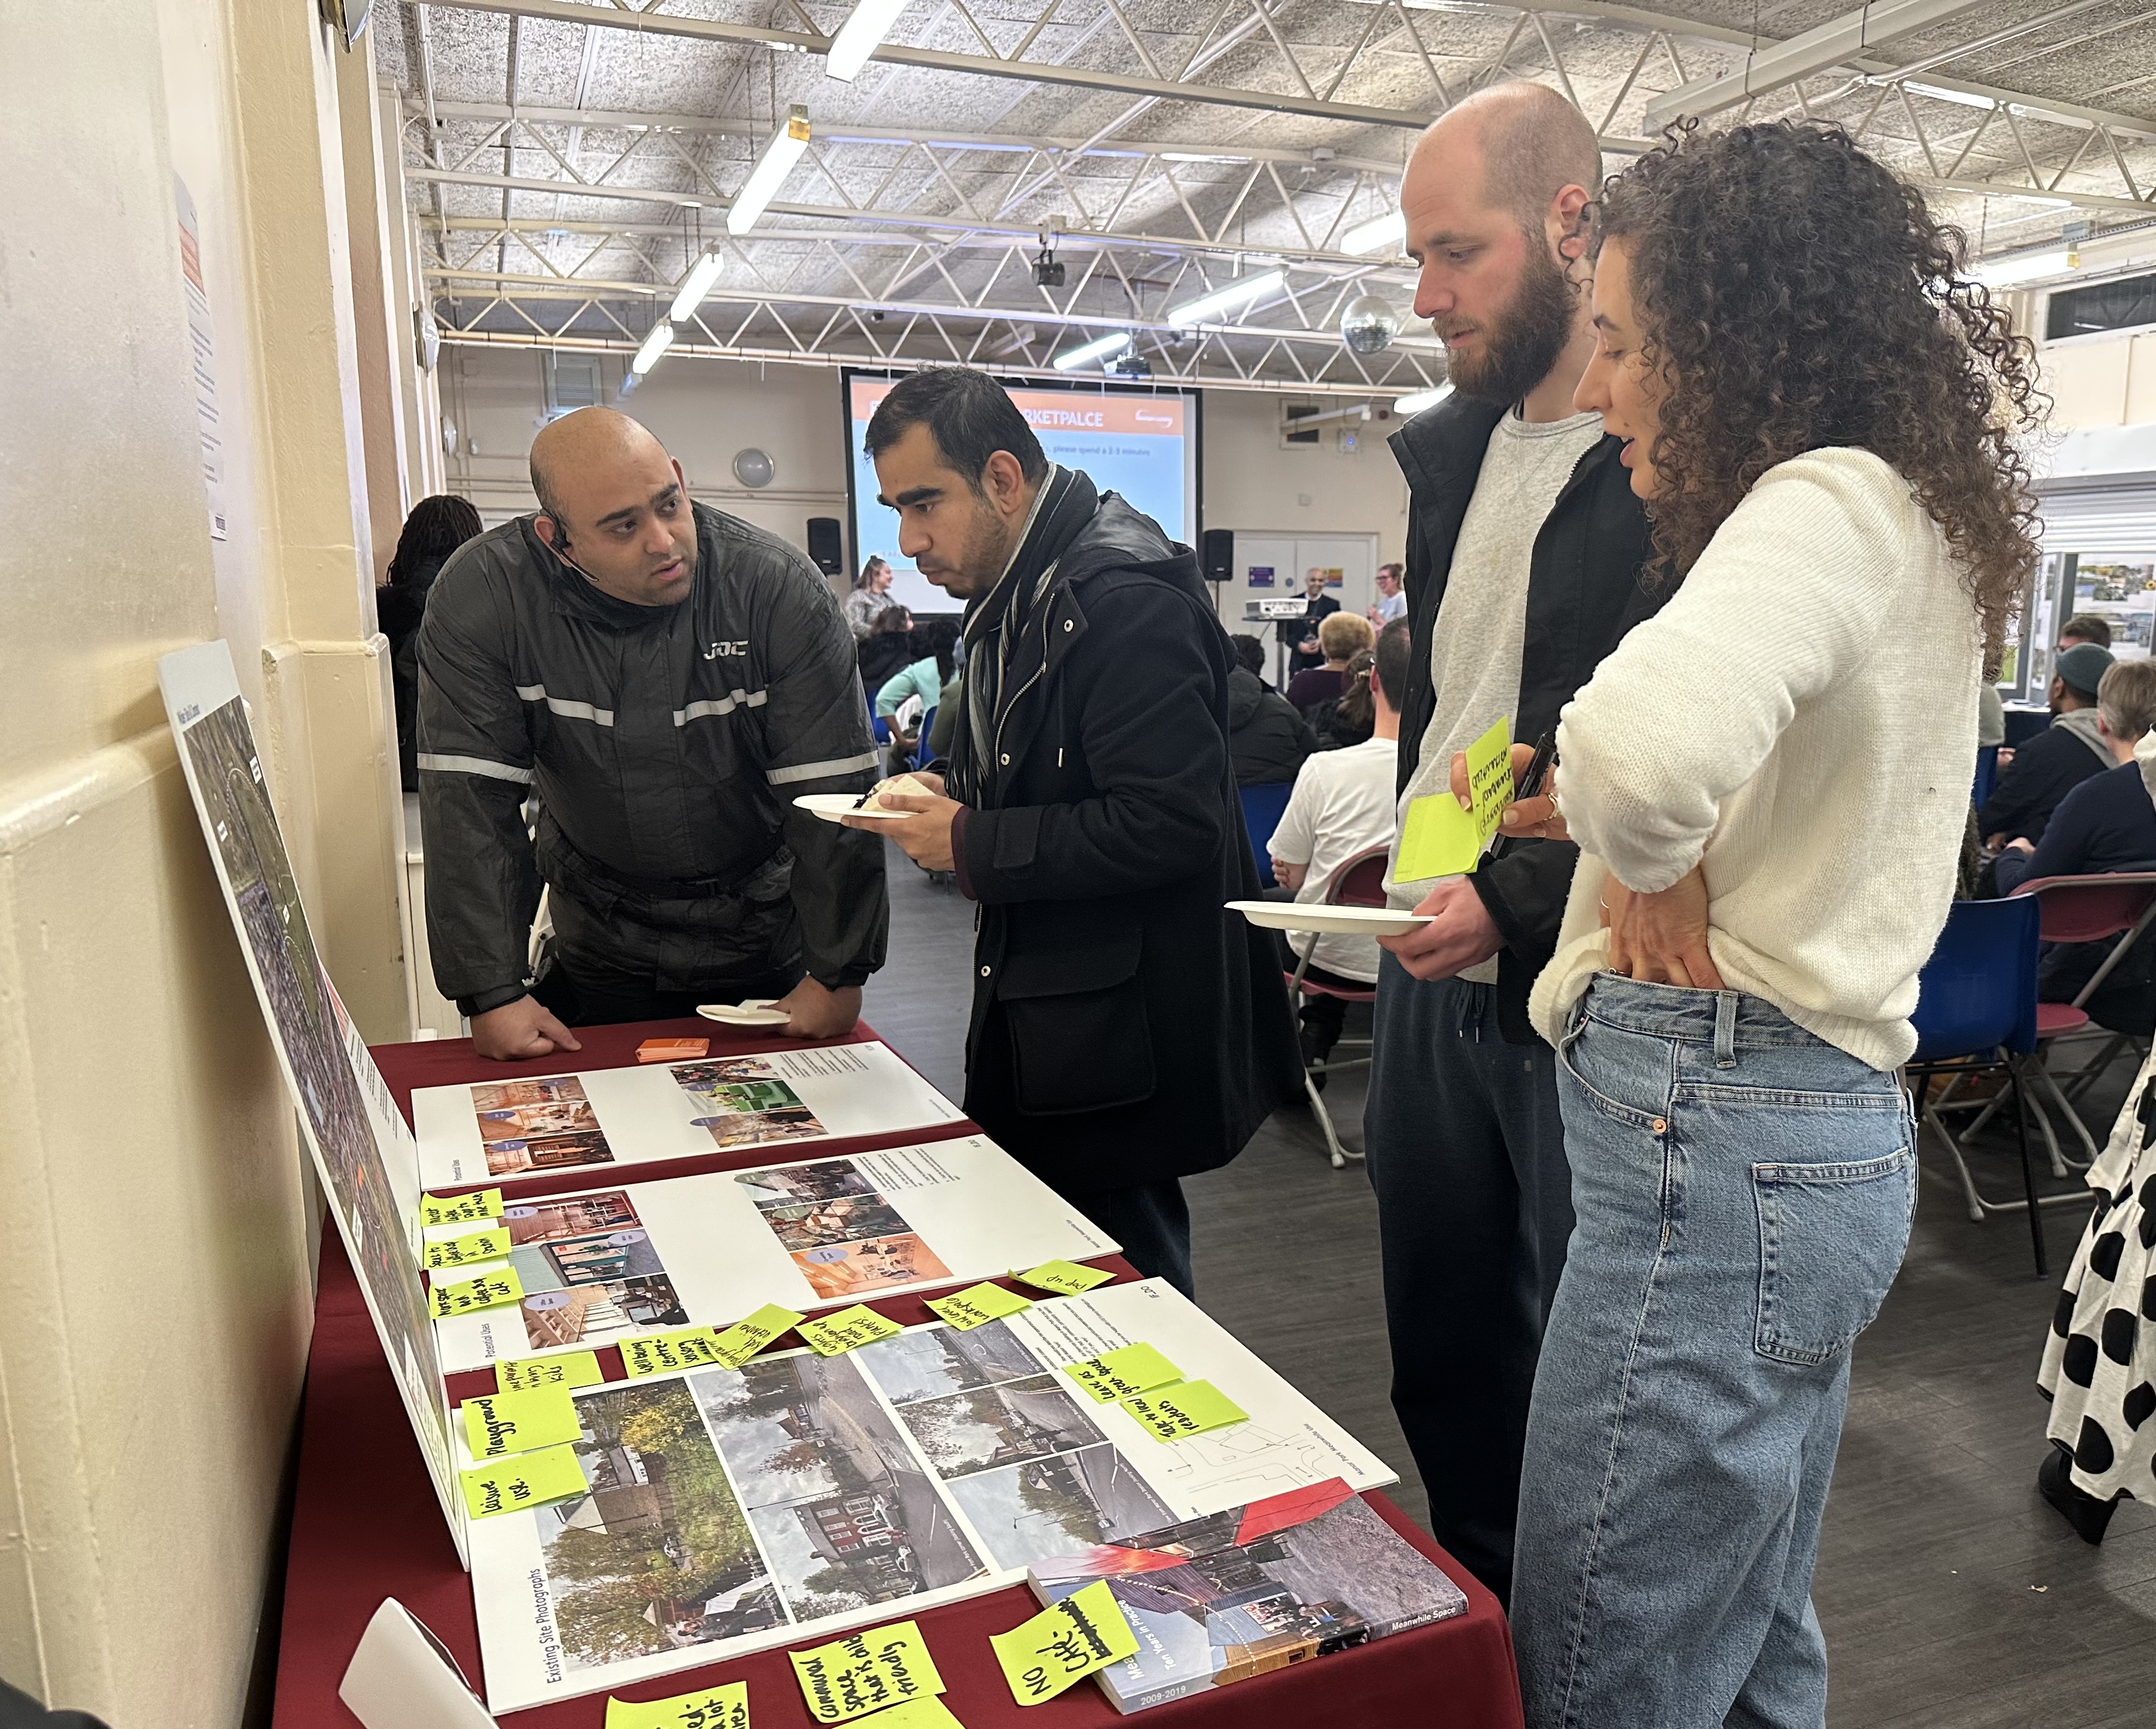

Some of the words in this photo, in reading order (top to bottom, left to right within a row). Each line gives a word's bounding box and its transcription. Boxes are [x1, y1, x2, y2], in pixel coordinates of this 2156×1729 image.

[1022, 408, 1104, 427] RKETPALCE
[1046, 1274, 1063, 1286] up
[1141, 1286, 1160, 1299] IF_DO
[480, 1323, 491, 1335] Uses
[482, 1335, 496, 1359] Potential
[1146, 1413, 1158, 1421] to
[471, 1399, 517, 1456] Playground
[1312, 1430, 1338, 1451] Meanwhile
[1335, 1451, 1349, 1462] Park
[1346, 1462, 1365, 1475] Manor
[527, 1568, 550, 1624] Photographs
[1118, 1599, 1144, 1629] Practice
[1392, 1613, 1432, 1631] Meanwhile
[1432, 1606, 1456, 1620] Space
[539, 1625, 554, 1644] Site
[1139, 1626, 1149, 1634] in
[1145, 1634, 1166, 1655] Years
[543, 1645, 562, 1684] Existing
[854, 1660, 873, 1677] is
[1162, 1653, 1177, 1671] Ten
[863, 1674, 890, 1703] that
[1141, 1685, 1186, 1706] 2009-2019
